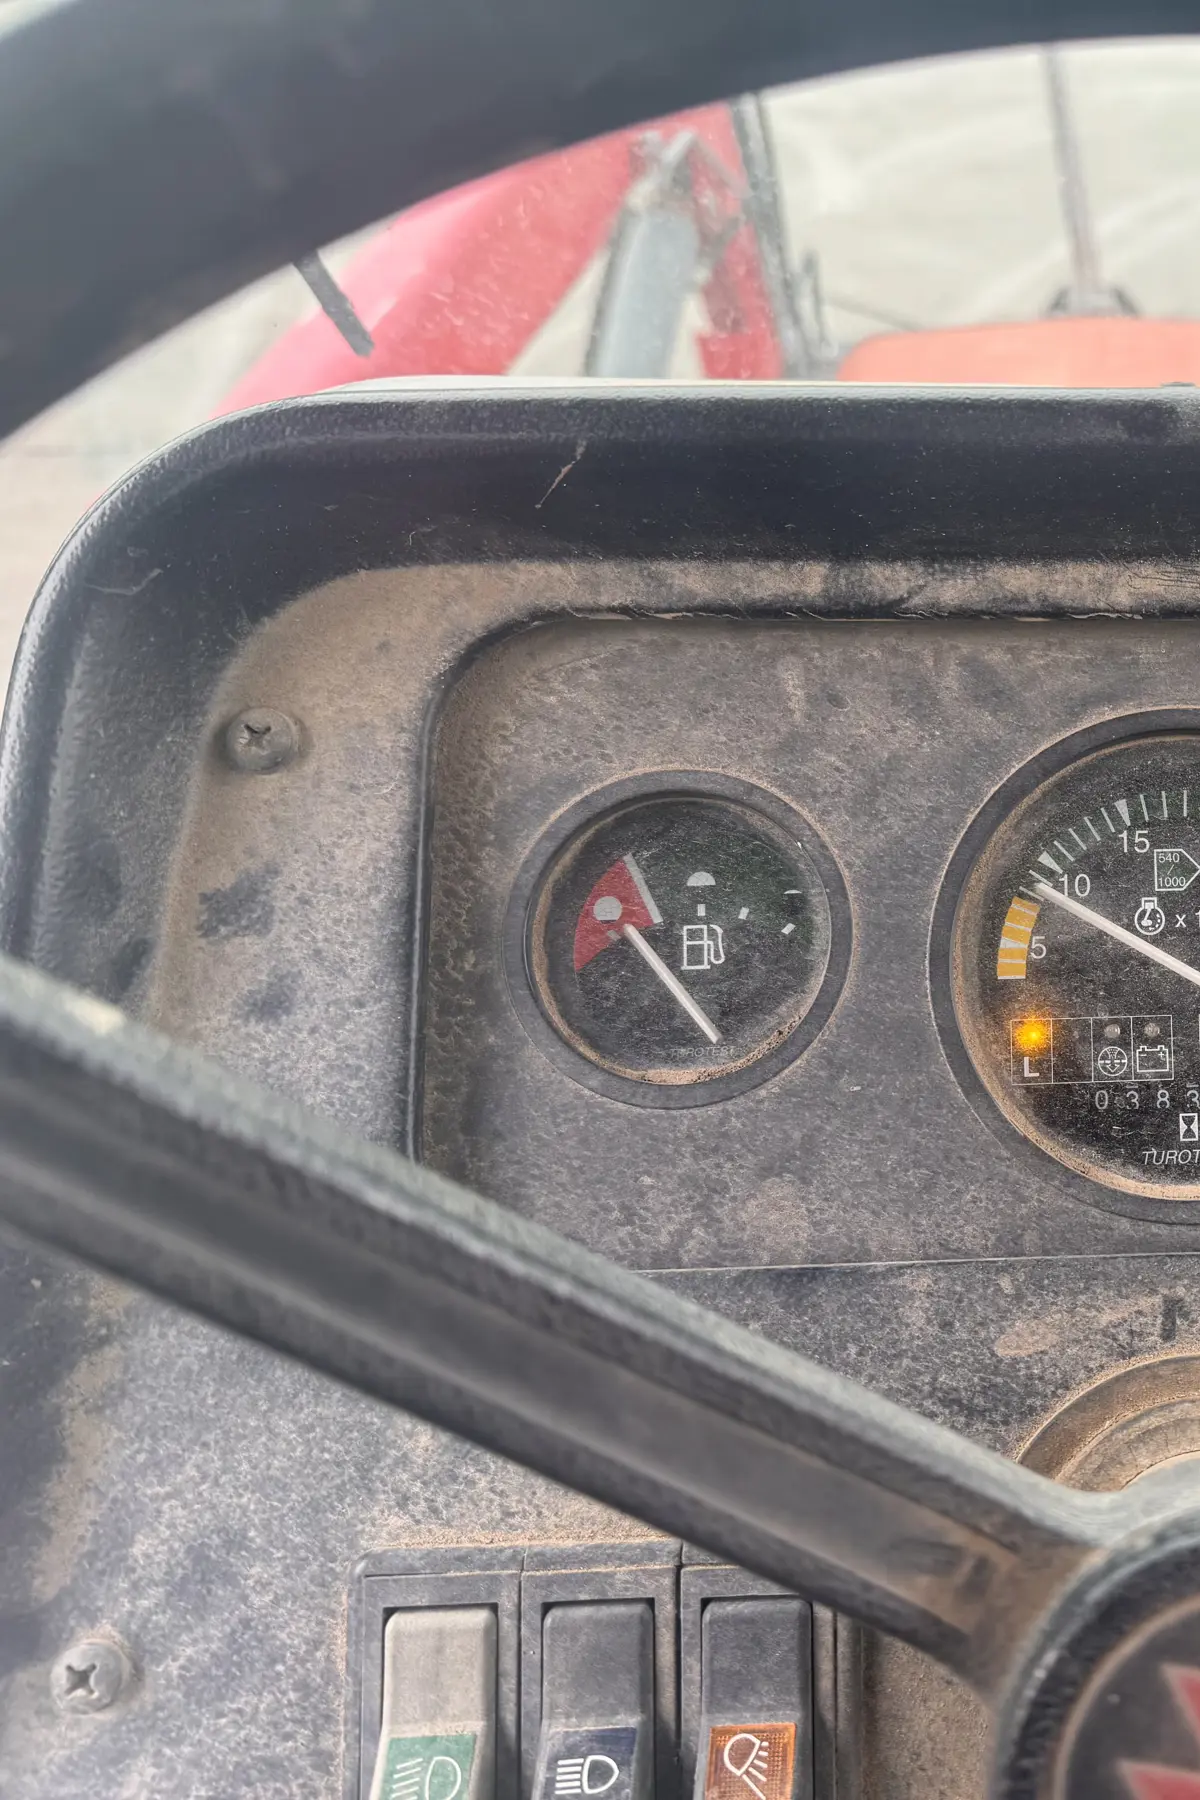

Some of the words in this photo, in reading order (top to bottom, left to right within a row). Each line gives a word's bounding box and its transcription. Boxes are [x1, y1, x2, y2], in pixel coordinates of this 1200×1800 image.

[1119, 830, 1150, 853] 15
[1158, 853, 1180, 863] 540
[1059, 874, 1091, 897] 10
[1158, 877, 1186, 887] 1000
[1031, 936, 1047, 959] 5
[1024, 1057, 1040, 1078] L
